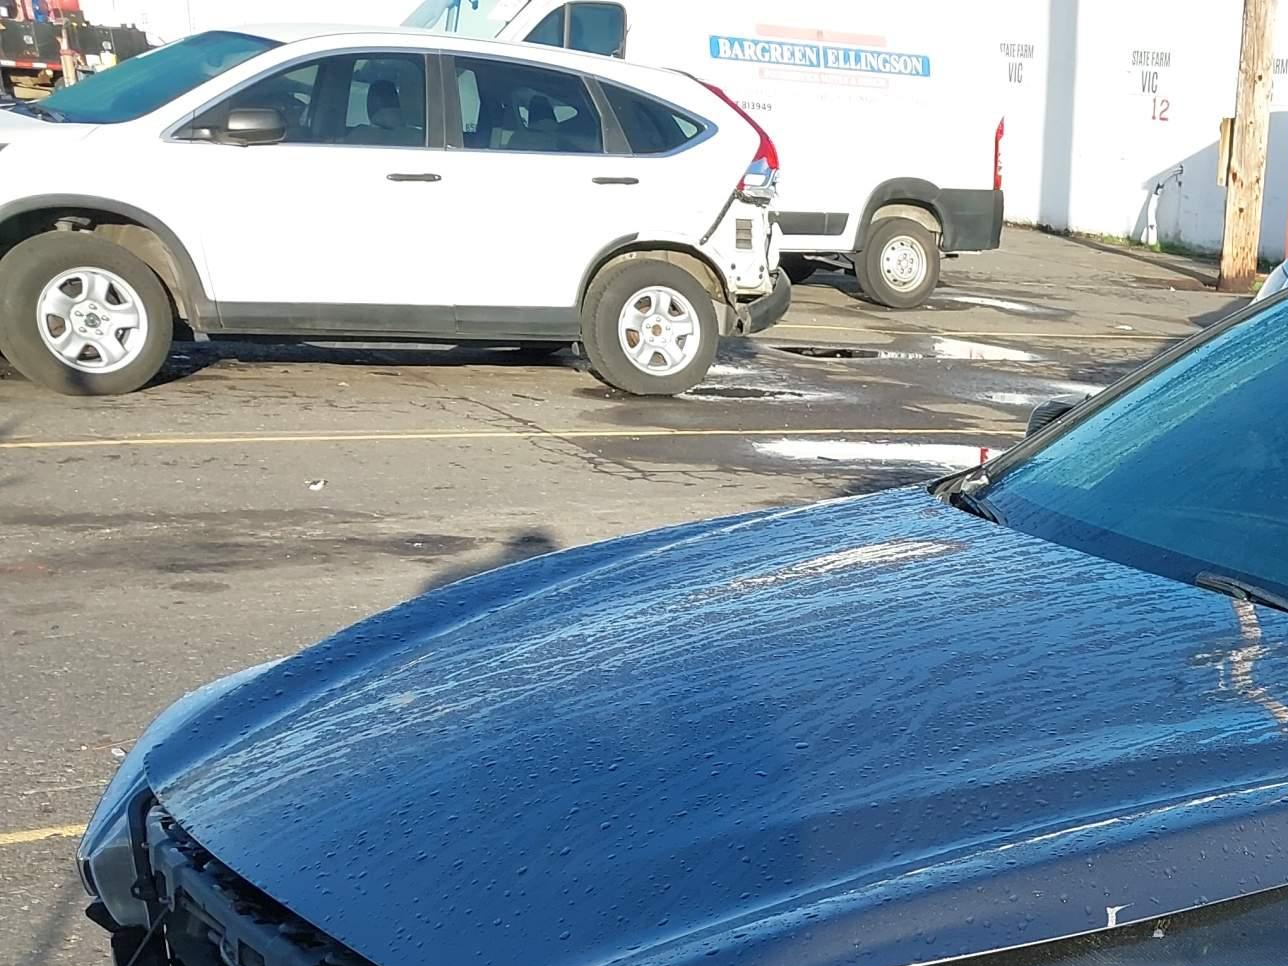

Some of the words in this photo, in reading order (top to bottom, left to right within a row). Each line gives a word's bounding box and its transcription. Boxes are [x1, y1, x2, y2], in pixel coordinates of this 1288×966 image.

[716, 37, 818, 66] BARGREEN
[826, 47, 924, 75] ELLINGSON
[1017, 43, 1034, 59] FARM
[1132, 50, 1150, 66] STATE
[1151, 51, 1171, 67] FARM
[1008, 61, 1023, 83] VIC
[1141, 70, 1158, 94] VIC
[1152, 97, 1170, 121] 12
